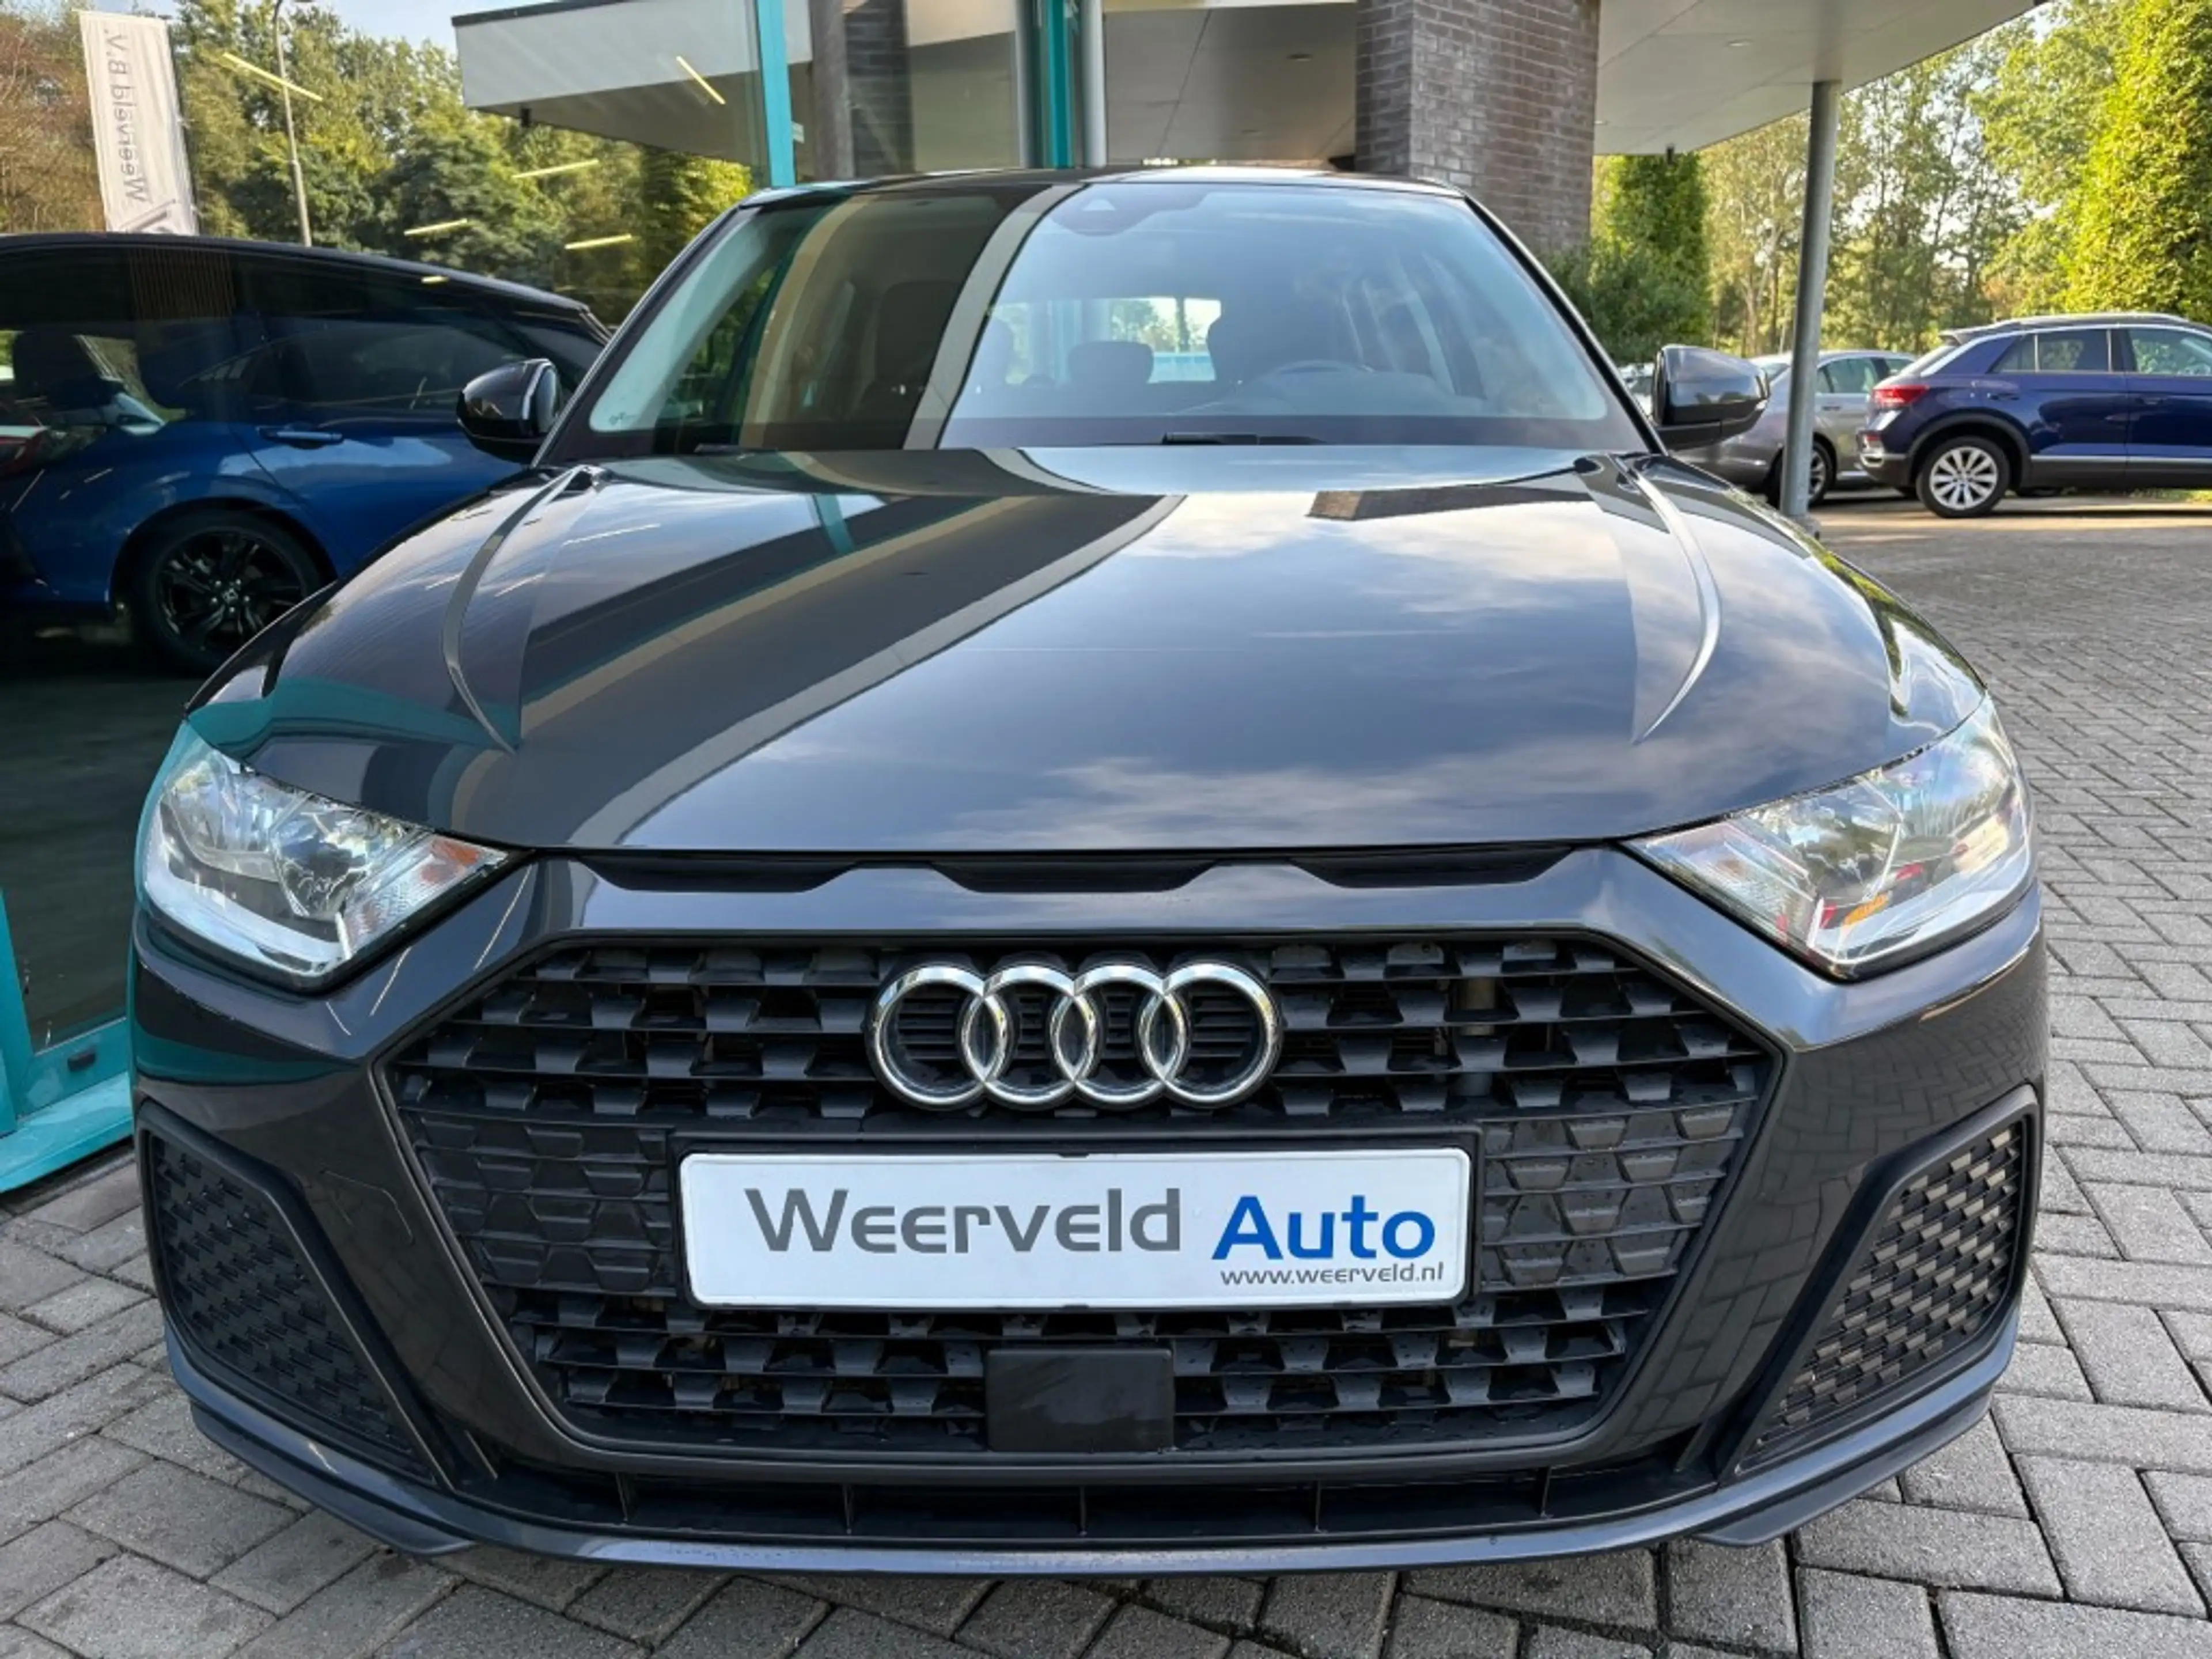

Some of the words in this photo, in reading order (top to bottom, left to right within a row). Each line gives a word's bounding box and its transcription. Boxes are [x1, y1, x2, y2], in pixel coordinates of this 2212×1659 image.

[744, 1188, 1180, 1253] Weerveld
[1211, 1195, 1435, 1260] Auto
[1220, 1261, 1444, 1286] www.weerveld.nl
